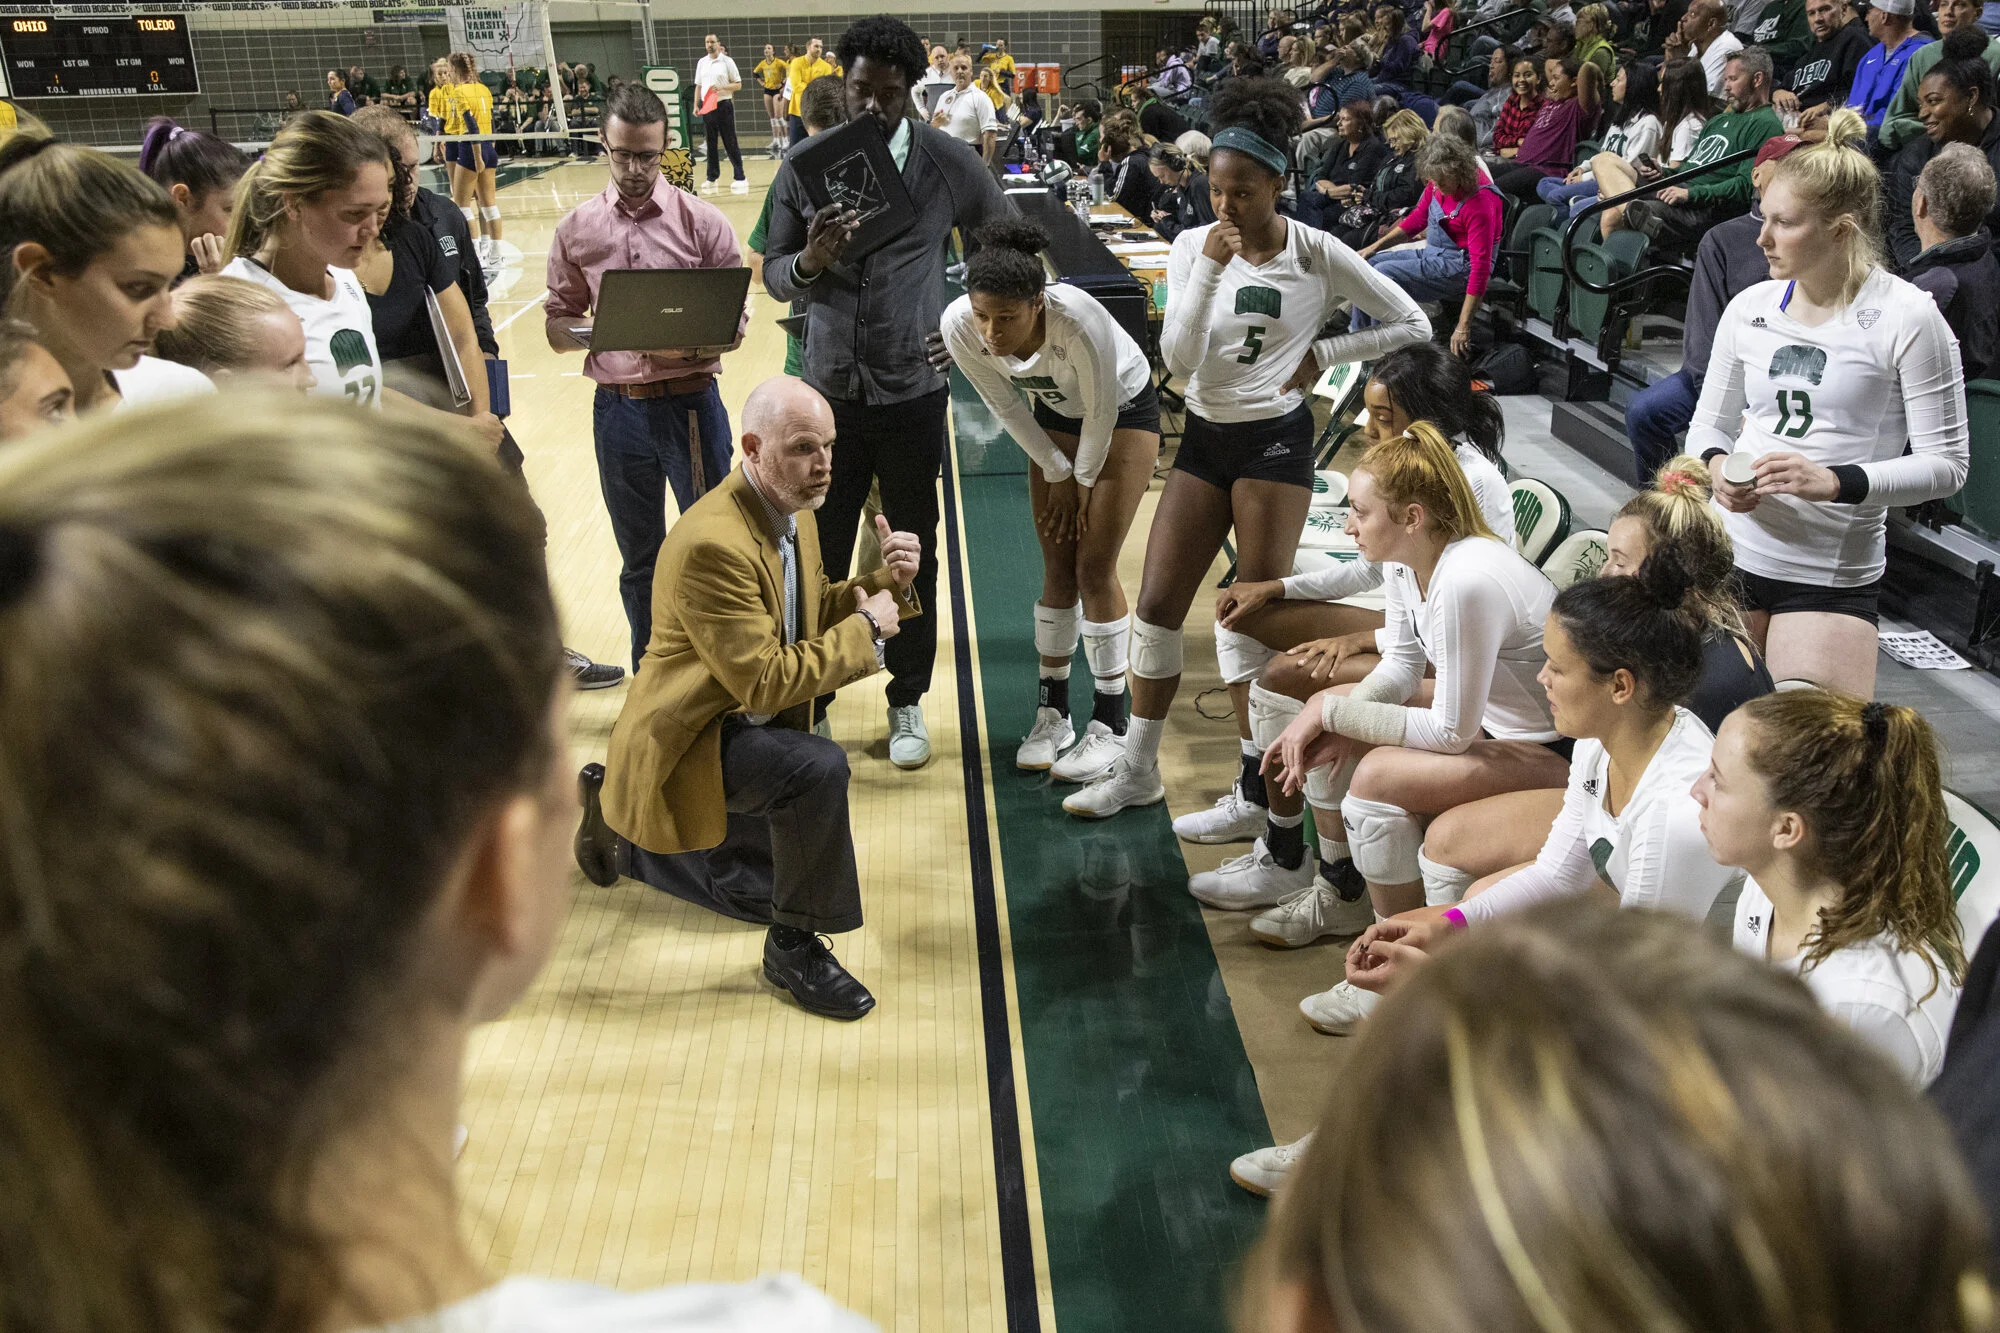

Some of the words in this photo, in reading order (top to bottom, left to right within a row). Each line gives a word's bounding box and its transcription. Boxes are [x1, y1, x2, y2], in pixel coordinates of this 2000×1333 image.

[1, 5, 19, 13] OHIO
[21, 5, 54, 13] BOBCATS
[72, 5, 91, 13] OHIO
[92, 4, 126, 12] BOBCATS
[163, 4, 196, 12] BOBCATS
[232, 2, 265, 10] BOBCATS
[282, 2, 300, 10] OHIO
[301, 2, 334, 10] BOBCATS
[466, 11, 502, 20] ALUMNI
[14, 20, 48, 32] OHIO
[137, 20, 176, 31] TOLEDO
[467, 20, 506, 30] VARSITY
[469, 31, 494, 40] BAND
[150, 70, 159, 82] 0
[1236, 326, 1266, 364] 5
[1772, 390, 1814, 438] 13
